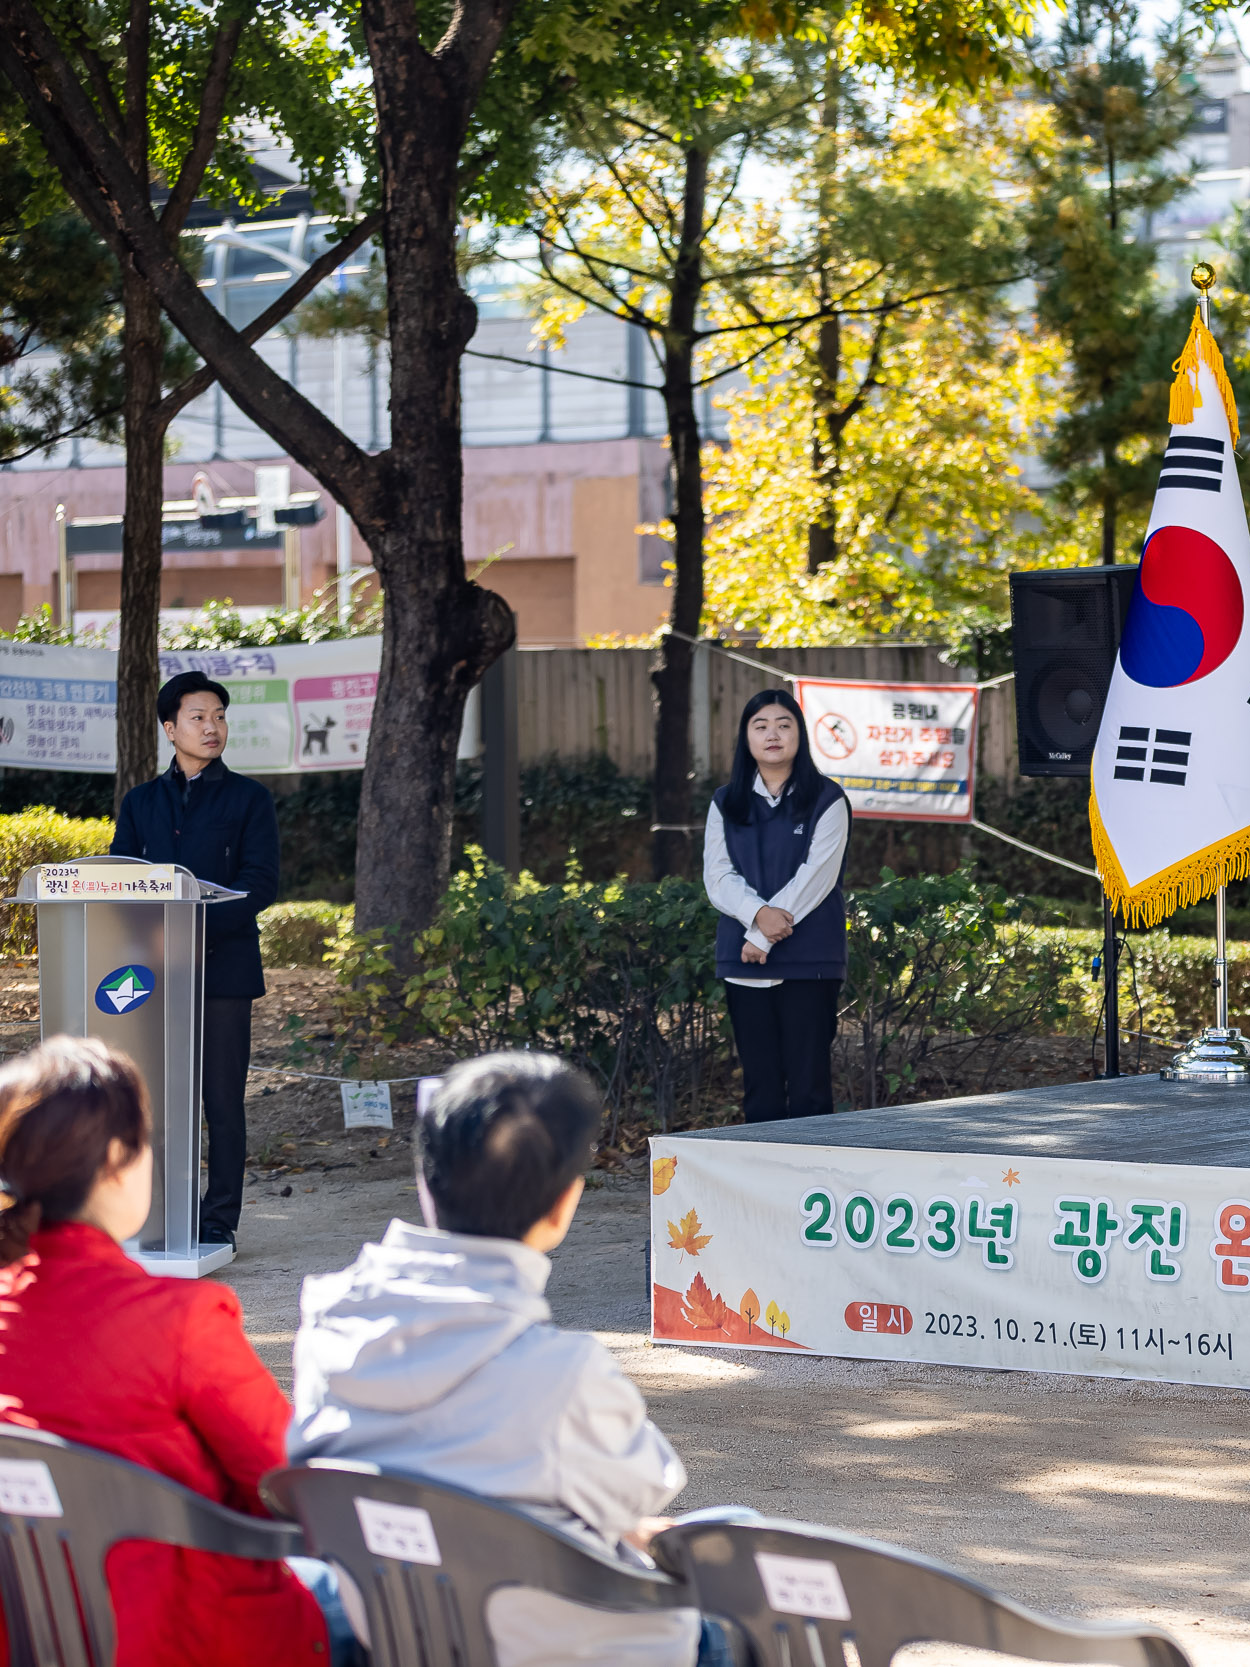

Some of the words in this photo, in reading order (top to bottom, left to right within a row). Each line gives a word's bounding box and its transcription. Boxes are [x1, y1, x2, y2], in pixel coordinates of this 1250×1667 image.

[866, 725, 914, 745] 자전거
[46, 868, 79, 877] 2023년
[45, 879, 68, 894] 광진
[124, 879, 172, 893] 가족축제
[803, 1192, 1014, 1265] 2023년
[1053, 1200, 1187, 1279] 광진
[859, 1304, 905, 1334] 일시
[1116, 1326, 1233, 1361] 11시~16시
